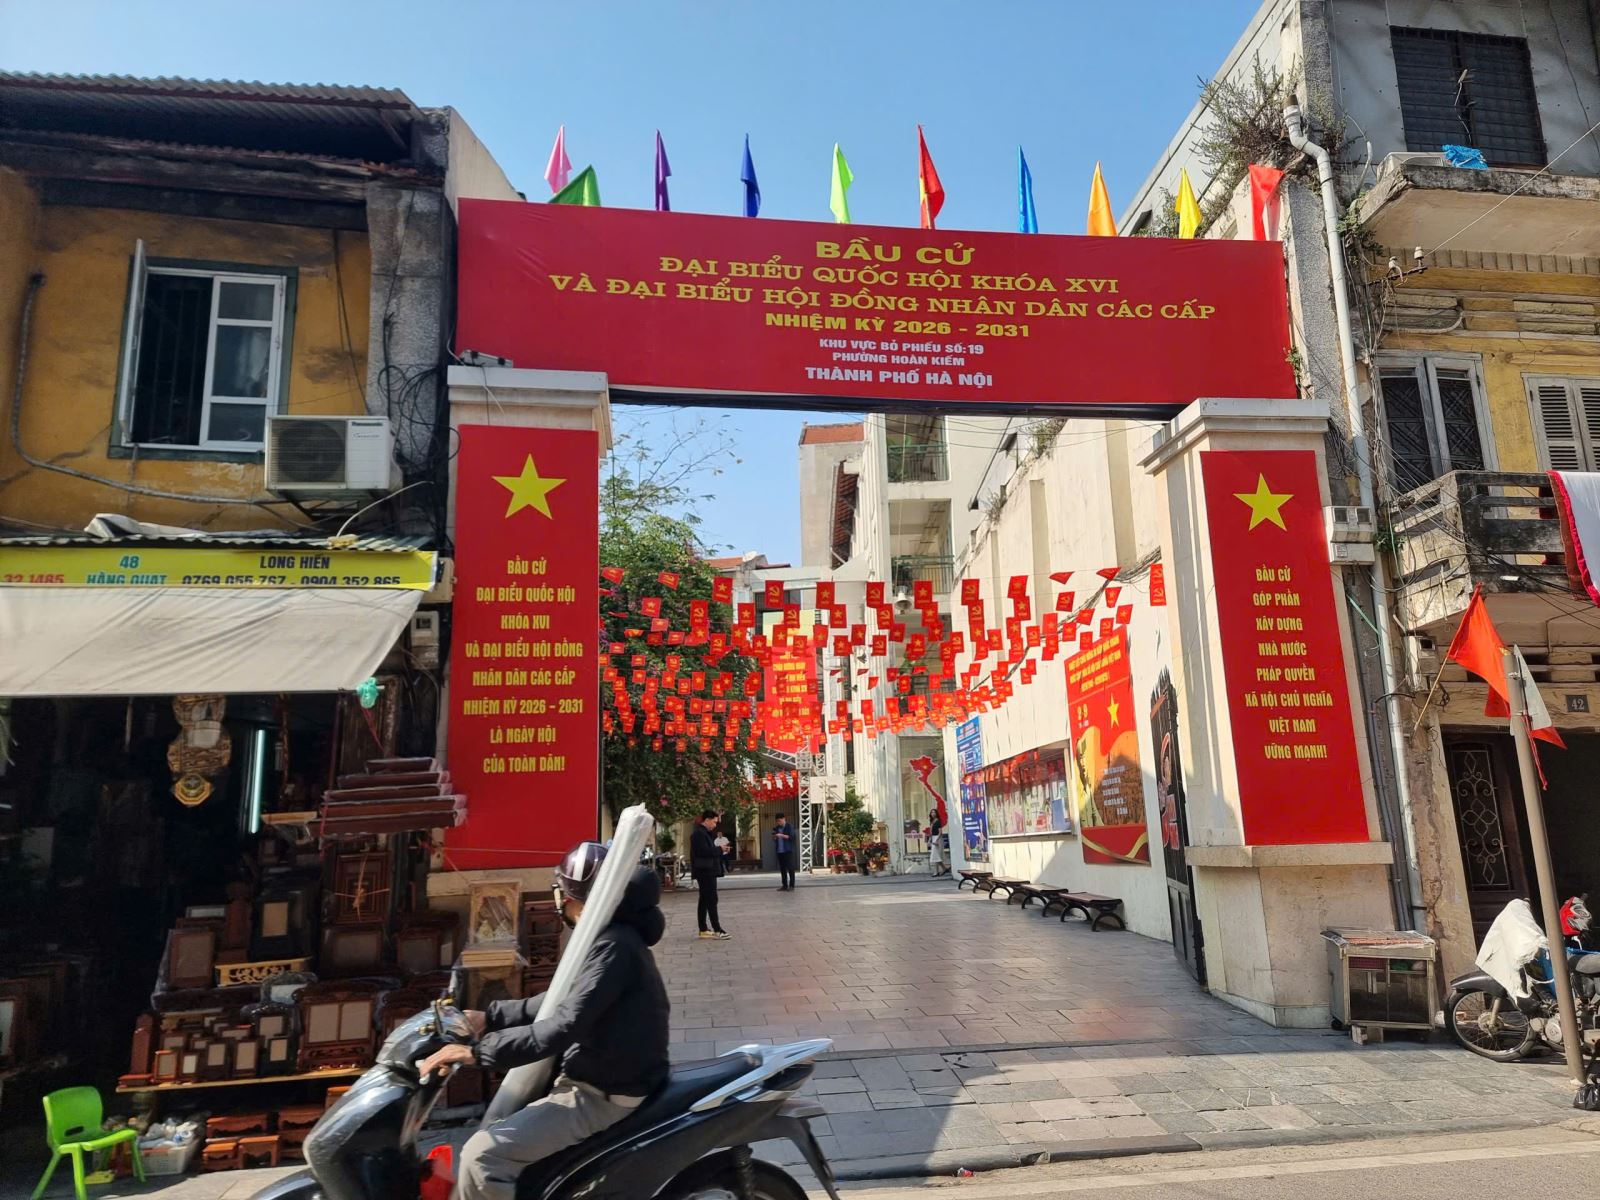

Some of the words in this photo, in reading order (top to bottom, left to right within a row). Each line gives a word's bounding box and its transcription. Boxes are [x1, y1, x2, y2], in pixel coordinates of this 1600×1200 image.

[816, 237, 900, 262] BẦU
[916, 242, 975, 265] CỬ
[660, 257, 718, 277] ĐẠI
[728, 255, 803, 280] BIỂU
[813, 264, 897, 285] QUỐC
[906, 269, 961, 291] HỘI
[971, 273, 1057, 291] KHÓA
[1065, 279, 1118, 293] XVI
[549, 273, 596, 292] VÀ
[607, 279, 666, 299] ĐẠI
[676, 277, 752, 302] BIỂU
[763, 286, 820, 309] HỘI
[830, 287, 919, 311] ĐỒNG
[927, 296, 1016, 315] NHÂN
[1024, 298, 1088, 316] DÂN
[1097, 300, 1152, 318] CÁC
[1161, 299, 1215, 318] CẤP
[766, 313, 846, 331] NHIỆM
[854, 314, 885, 331] KỲ
[894, 321, 951, 334] 2026
[976, 323, 1031, 337] 2031
[820, 339, 846, 348] KHU
[851, 340, 876, 353] VỰC
[902, 342, 941, 352] PHIẾU
[833, 352, 887, 363] PHƯỜNG
[891, 354, 927, 364] HOÀN
[932, 355, 964, 366] KIẾM
[805, 366, 872, 381] THÀNH
[879, 369, 919, 384] PHỐ
[926, 371, 952, 384] HÀ
[959, 372, 992, 388] NỘI
[120, 555, 139, 569] 48
[260, 555, 295, 569] LONG
[508, 555, 528, 574] BẦU
[532, 557, 546, 574] CỬ
[1256, 565, 1275, 581] BẦU
[1278, 566, 1290, 581] CỬ
[477, 587, 495, 604] ĐẠI
[498, 582, 522, 601] BIỂU
[526, 583, 554, 602] QUỐC
[557, 587, 575, 605] HỘI
[1253, 591, 1272, 606] GÓP
[1275, 589, 1300, 605] PHẦN
[501, 615, 529, 629] KHÓA
[533, 615, 549, 629] XVI
[1256, 616, 1273, 630] XÂY
[1277, 617, 1303, 633] DỰNG
[466, 641, 479, 657] VÀ
[483, 643, 501, 660] ĐẠI
[505, 637, 529, 657] BIỂU
[533, 640, 550, 660] HỘI
[554, 638, 583, 657] ĐỒNG
[1259, 641, 1278, 655] NHÀ
[1281, 642, 1306, 655] NƯỚC
[473, 669, 502, 685] NHÂN
[506, 668, 527, 685] DÂN
[531, 668, 551, 685] CÁC
[555, 666, 575, 685] CẤP
[1257, 666, 1281, 681] PHÁP
[1285, 663, 1315, 681] QUYỀN
[463, 697, 500, 717] NHIỆM
[504, 697, 517, 714] KỲ
[520, 700, 546, 713] 2026
[559, 699, 582, 713] 2031
[1245, 691, 1258, 706] XÃ
[1261, 691, 1277, 709] HỘI
[1280, 690, 1300, 706] CHỦ
[1303, 691, 1332, 706] NGHĨA
[1571, 698, 1585, 710] 42
[490, 725, 503, 743] LÀ
[506, 725, 535, 743] NGÀY
[537, 725, 556, 745] HỘI
[1269, 717, 1289, 735] VIỆT
[1293, 719, 1316, 732] NAM
[1264, 743, 1291, 759] VỮNG
[1294, 744, 1328, 762] MẠNH!
[484, 754, 505, 772] CỦA
[508, 754, 537, 773] TOÀN
[540, 754, 564, 771] DÂN!
